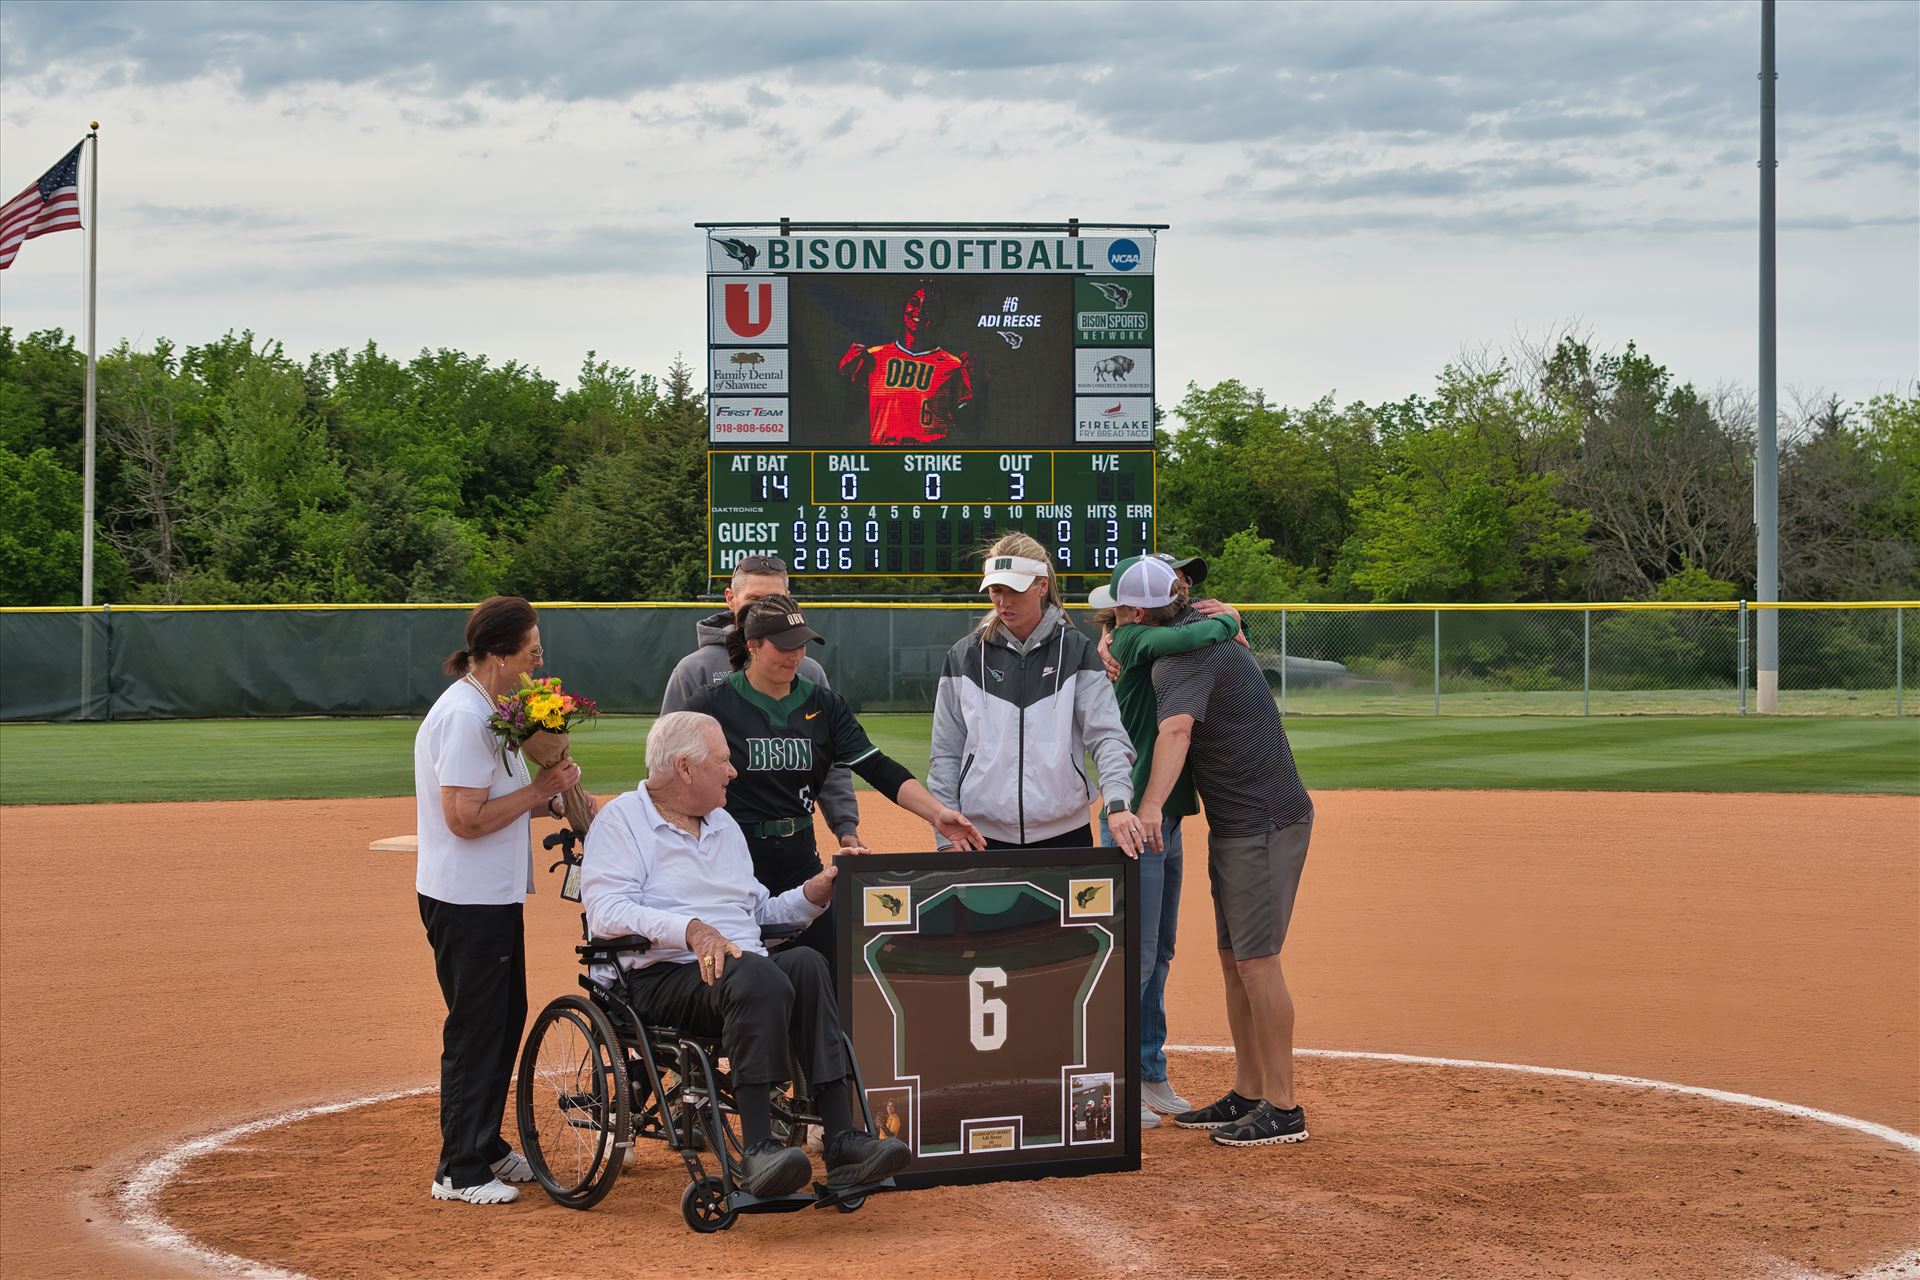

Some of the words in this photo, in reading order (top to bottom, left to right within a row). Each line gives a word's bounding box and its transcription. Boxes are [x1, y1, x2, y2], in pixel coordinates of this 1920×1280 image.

[768, 239, 886, 270] BISON
[904, 239, 1094, 270] SOFTBALL
[1111, 254, 1139, 264] NCAA
[1002, 296, 1019, 312] #6
[977, 314, 1000, 328] ADI
[1003, 314, 1042, 328] REESE
[1082, 314, 1106, 328] BISON
[1108, 314, 1145, 328] SPORTS
[1083, 331, 1143, 340] NETWORK
[714, 370, 748, 382] Family
[750, 370, 784, 380] Dental
[885, 358, 936, 392] OBU
[716, 380, 725, 390] of
[725, 380, 768, 390] Shawnee
[752, 407, 784, 416] TEAM
[716, 424, 784, 433] 918-808-6602
[1080, 421, 1149, 430] FIRELAKE
[731, 455, 752, 472] AT
[756, 455, 788, 472] BAT
[828, 455, 870, 472] BALL
[904, 454, 962, 472] STRIKE
[1000, 454, 1032, 471] OUT
[1092, 454, 1119, 472] H/E
[762, 475, 788, 499] 14
[842, 473, 857, 500] 0
[926, 473, 940, 500] 0
[1010, 473, 1024, 500] 3
[797, 505, 804, 519] 1
[818, 505, 826, 519] 2
[840, 505, 848, 519] 3
[868, 505, 876, 519] 4
[891, 505, 898, 519] 5
[912, 505, 920, 519] 6
[940, 505, 948, 519] 7
[962, 505, 970, 519] 8
[984, 505, 991, 519] 9
[1008, 505, 1023, 519] 10
[1036, 505, 1072, 518] RUNS
[1087, 505, 1117, 518] HITS
[1126, 505, 1152, 518] ERR
[718, 522, 780, 542] GUEST
[794, 521, 807, 542] 0
[816, 521, 829, 542] 0
[839, 521, 852, 542] 0
[866, 521, 878, 542] 0
[1058, 520, 1071, 542] 0
[1107, 520, 1118, 541] 3
[1142, 522, 1146, 540] 1
[794, 548, 807, 569] 2
[816, 548, 829, 569] 0
[839, 548, 852, 569] 6
[875, 549, 879, 568] 1
[1058, 547, 1071, 568] 9
[1095, 547, 1118, 568] 10
[994, 558, 1012, 570] OBU
[787, 613, 804, 626] OBU
[746, 738, 812, 770] BISON
[969, 966, 1007, 1051] 6
